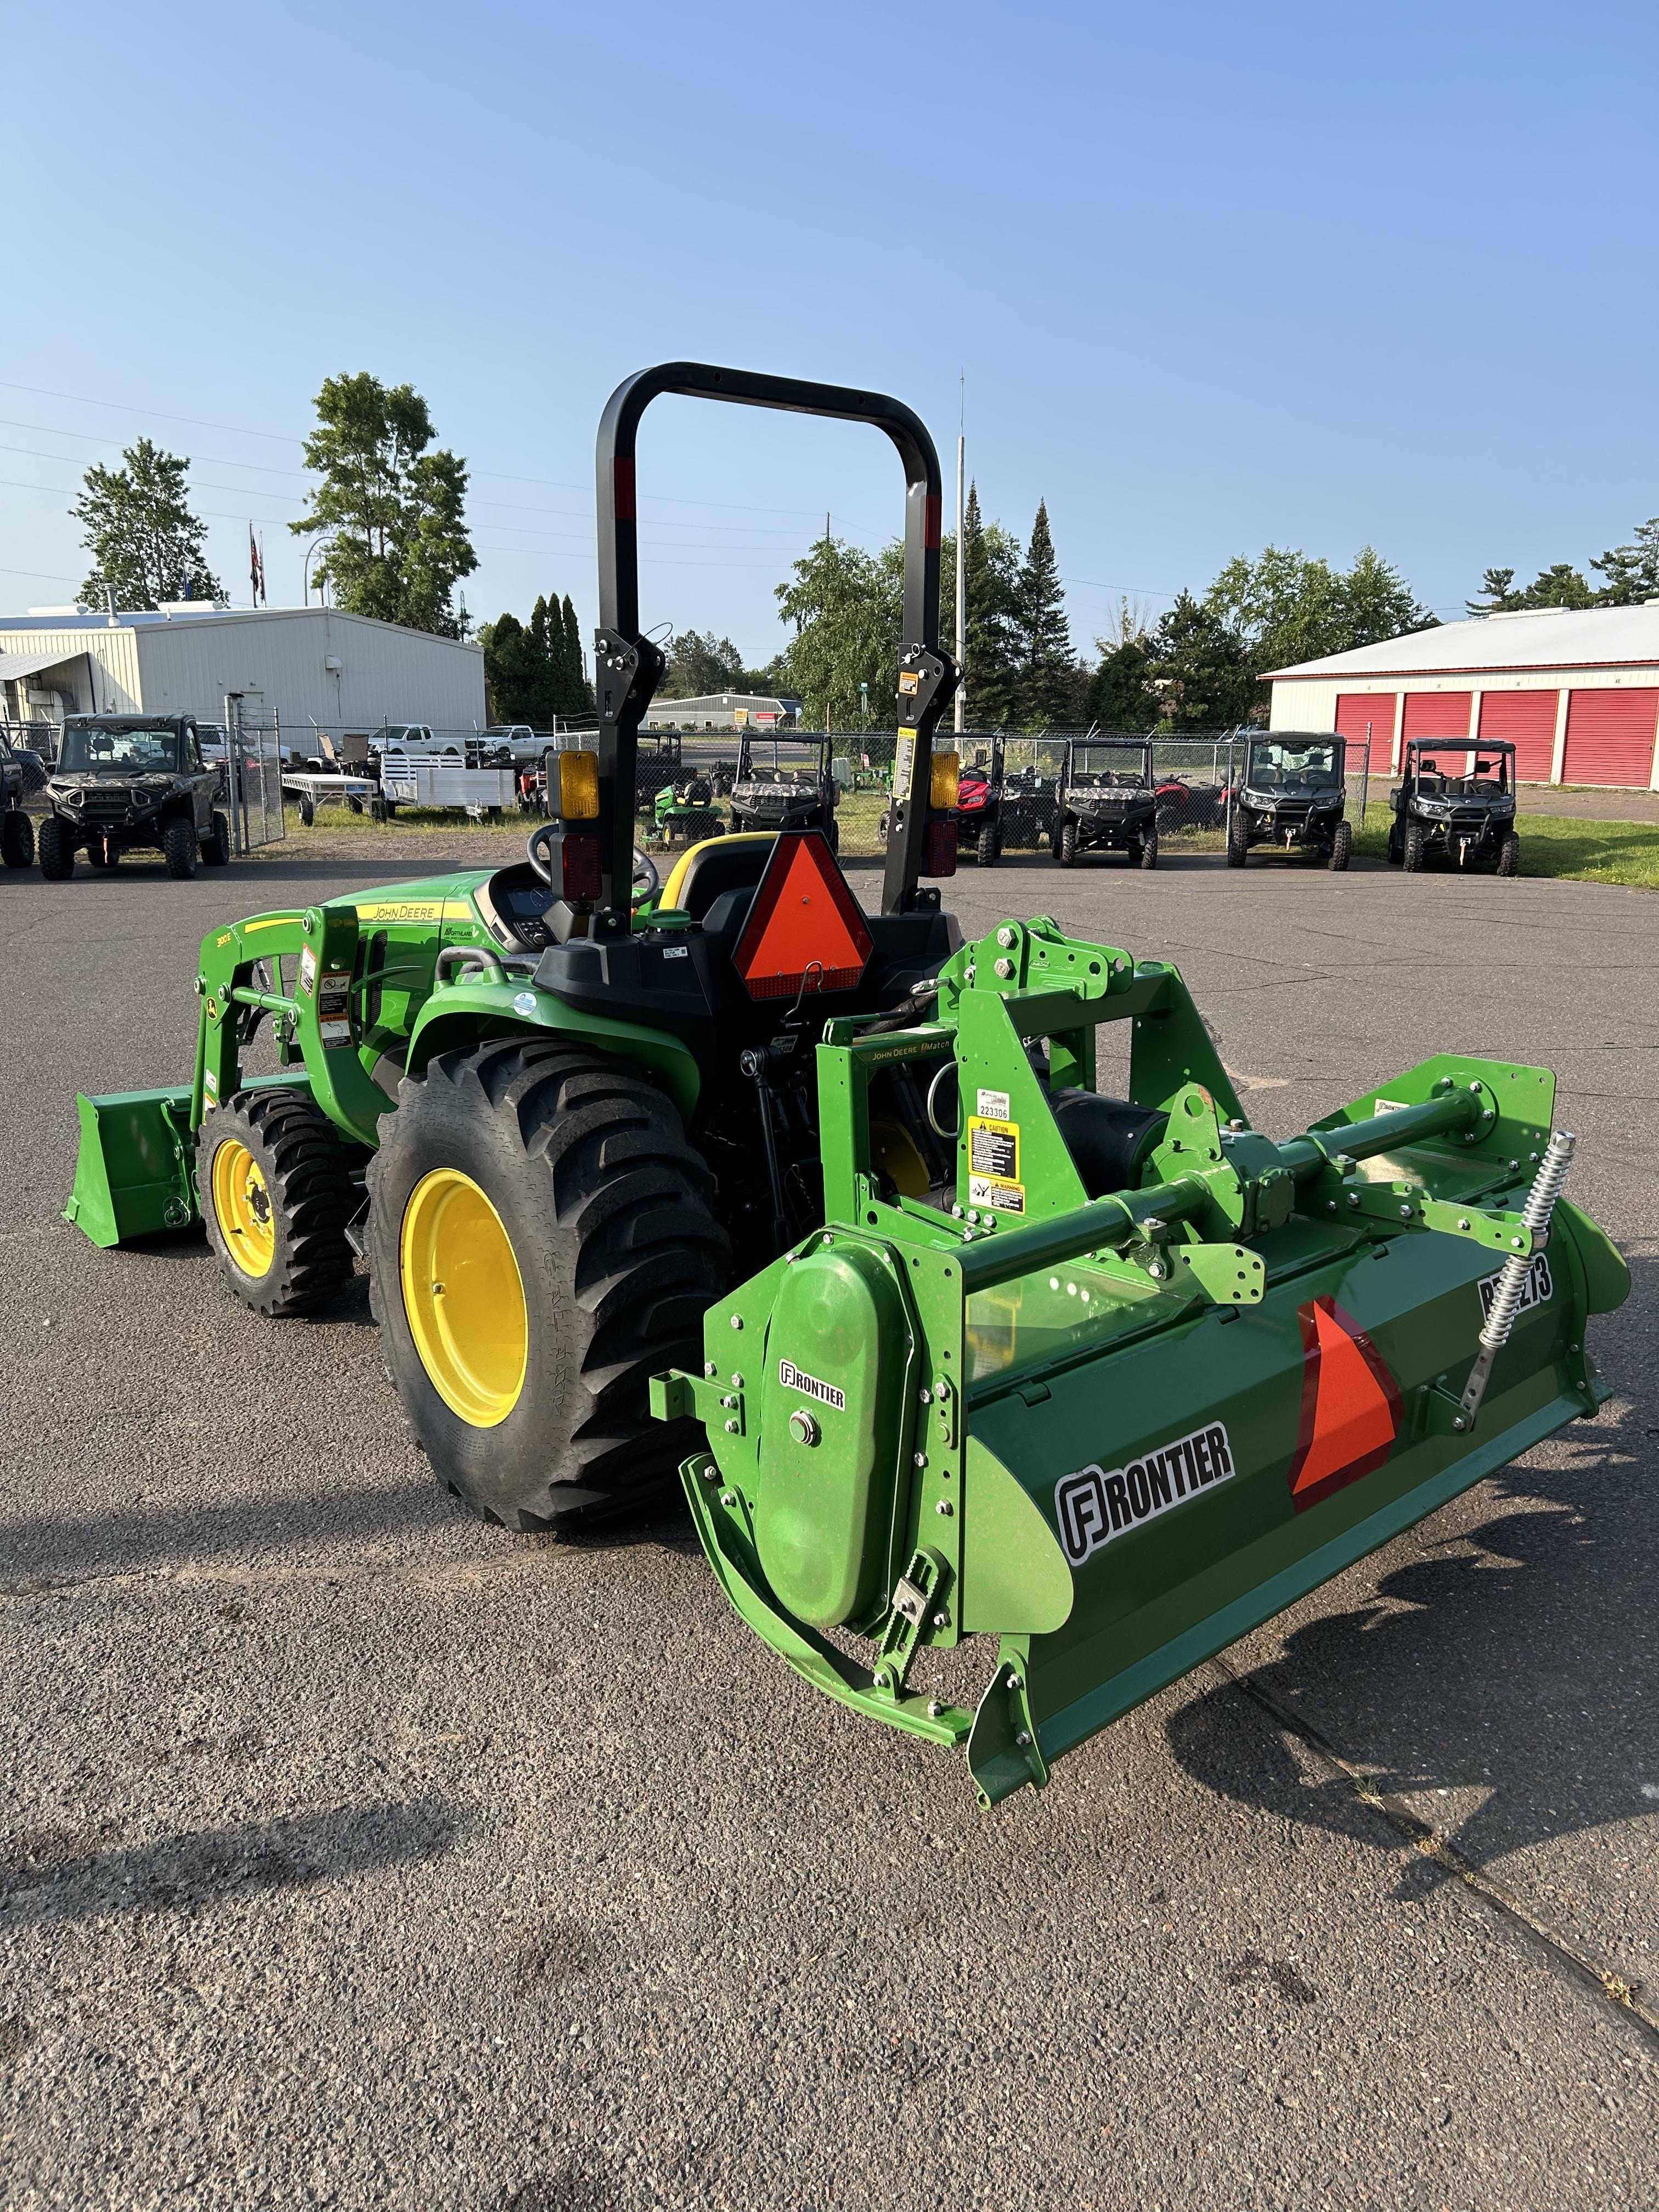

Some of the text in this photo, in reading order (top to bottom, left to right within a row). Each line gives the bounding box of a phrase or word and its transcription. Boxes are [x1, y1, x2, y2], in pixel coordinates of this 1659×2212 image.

[373, 906, 435, 918] JOHN DEERE
[217, 932, 231, 948] 300E
[872, 1051, 892, 1060] JOHN
[894, 1047, 918, 1056] DEERE
[980, 1105, 1007, 1119] 223306
[989, 1125, 1008, 1133] CAUTION
[1000, 1183, 1020, 1192] WARNING
[781, 1362, 843, 1408] FRONTIER
[1059, 1426, 1232, 1560] FRONTIER
